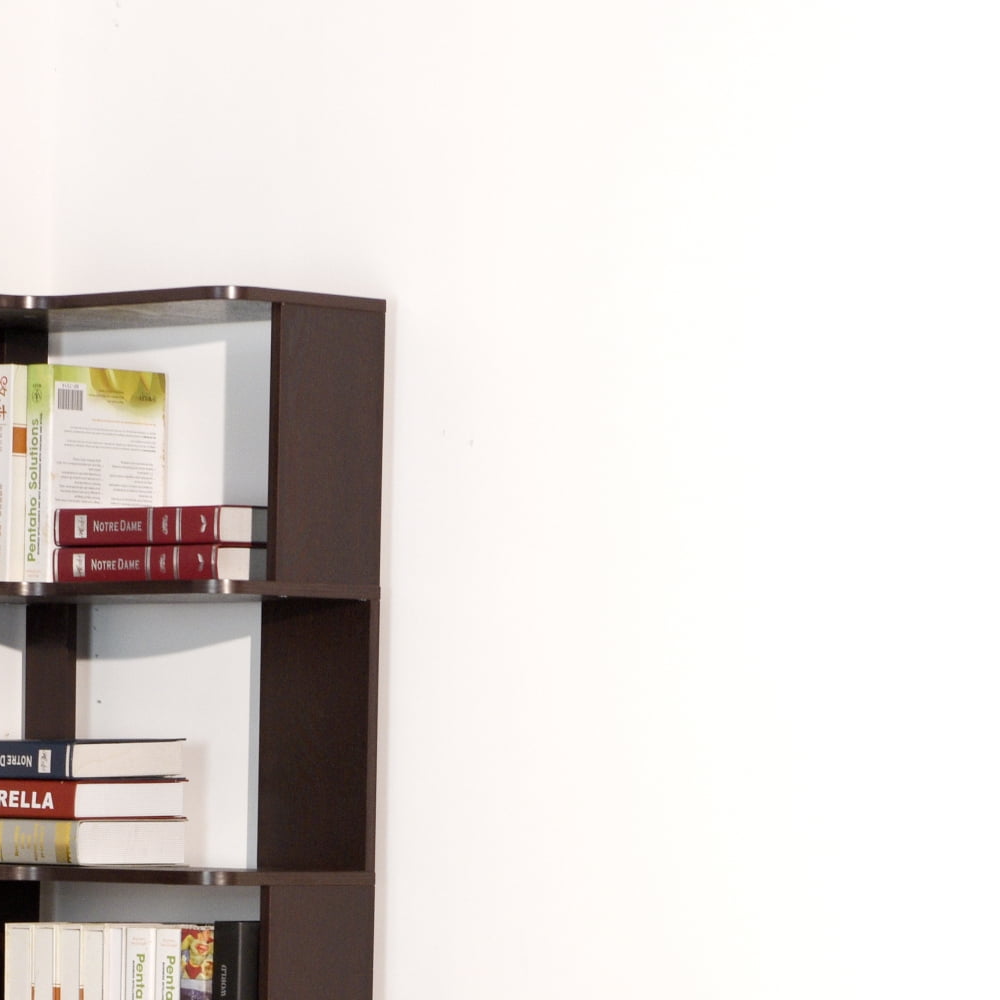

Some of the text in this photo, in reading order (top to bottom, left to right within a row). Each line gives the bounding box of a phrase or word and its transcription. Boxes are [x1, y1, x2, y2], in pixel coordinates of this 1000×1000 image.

[28, 418, 39, 490] Solutions
[27, 497, 37, 562] Pentaho
[93, 519, 142, 532] NOTRE DAME
[91, 558, 140, 571] NOTRE DAME
[7, 755, 33, 768] NOTRE
